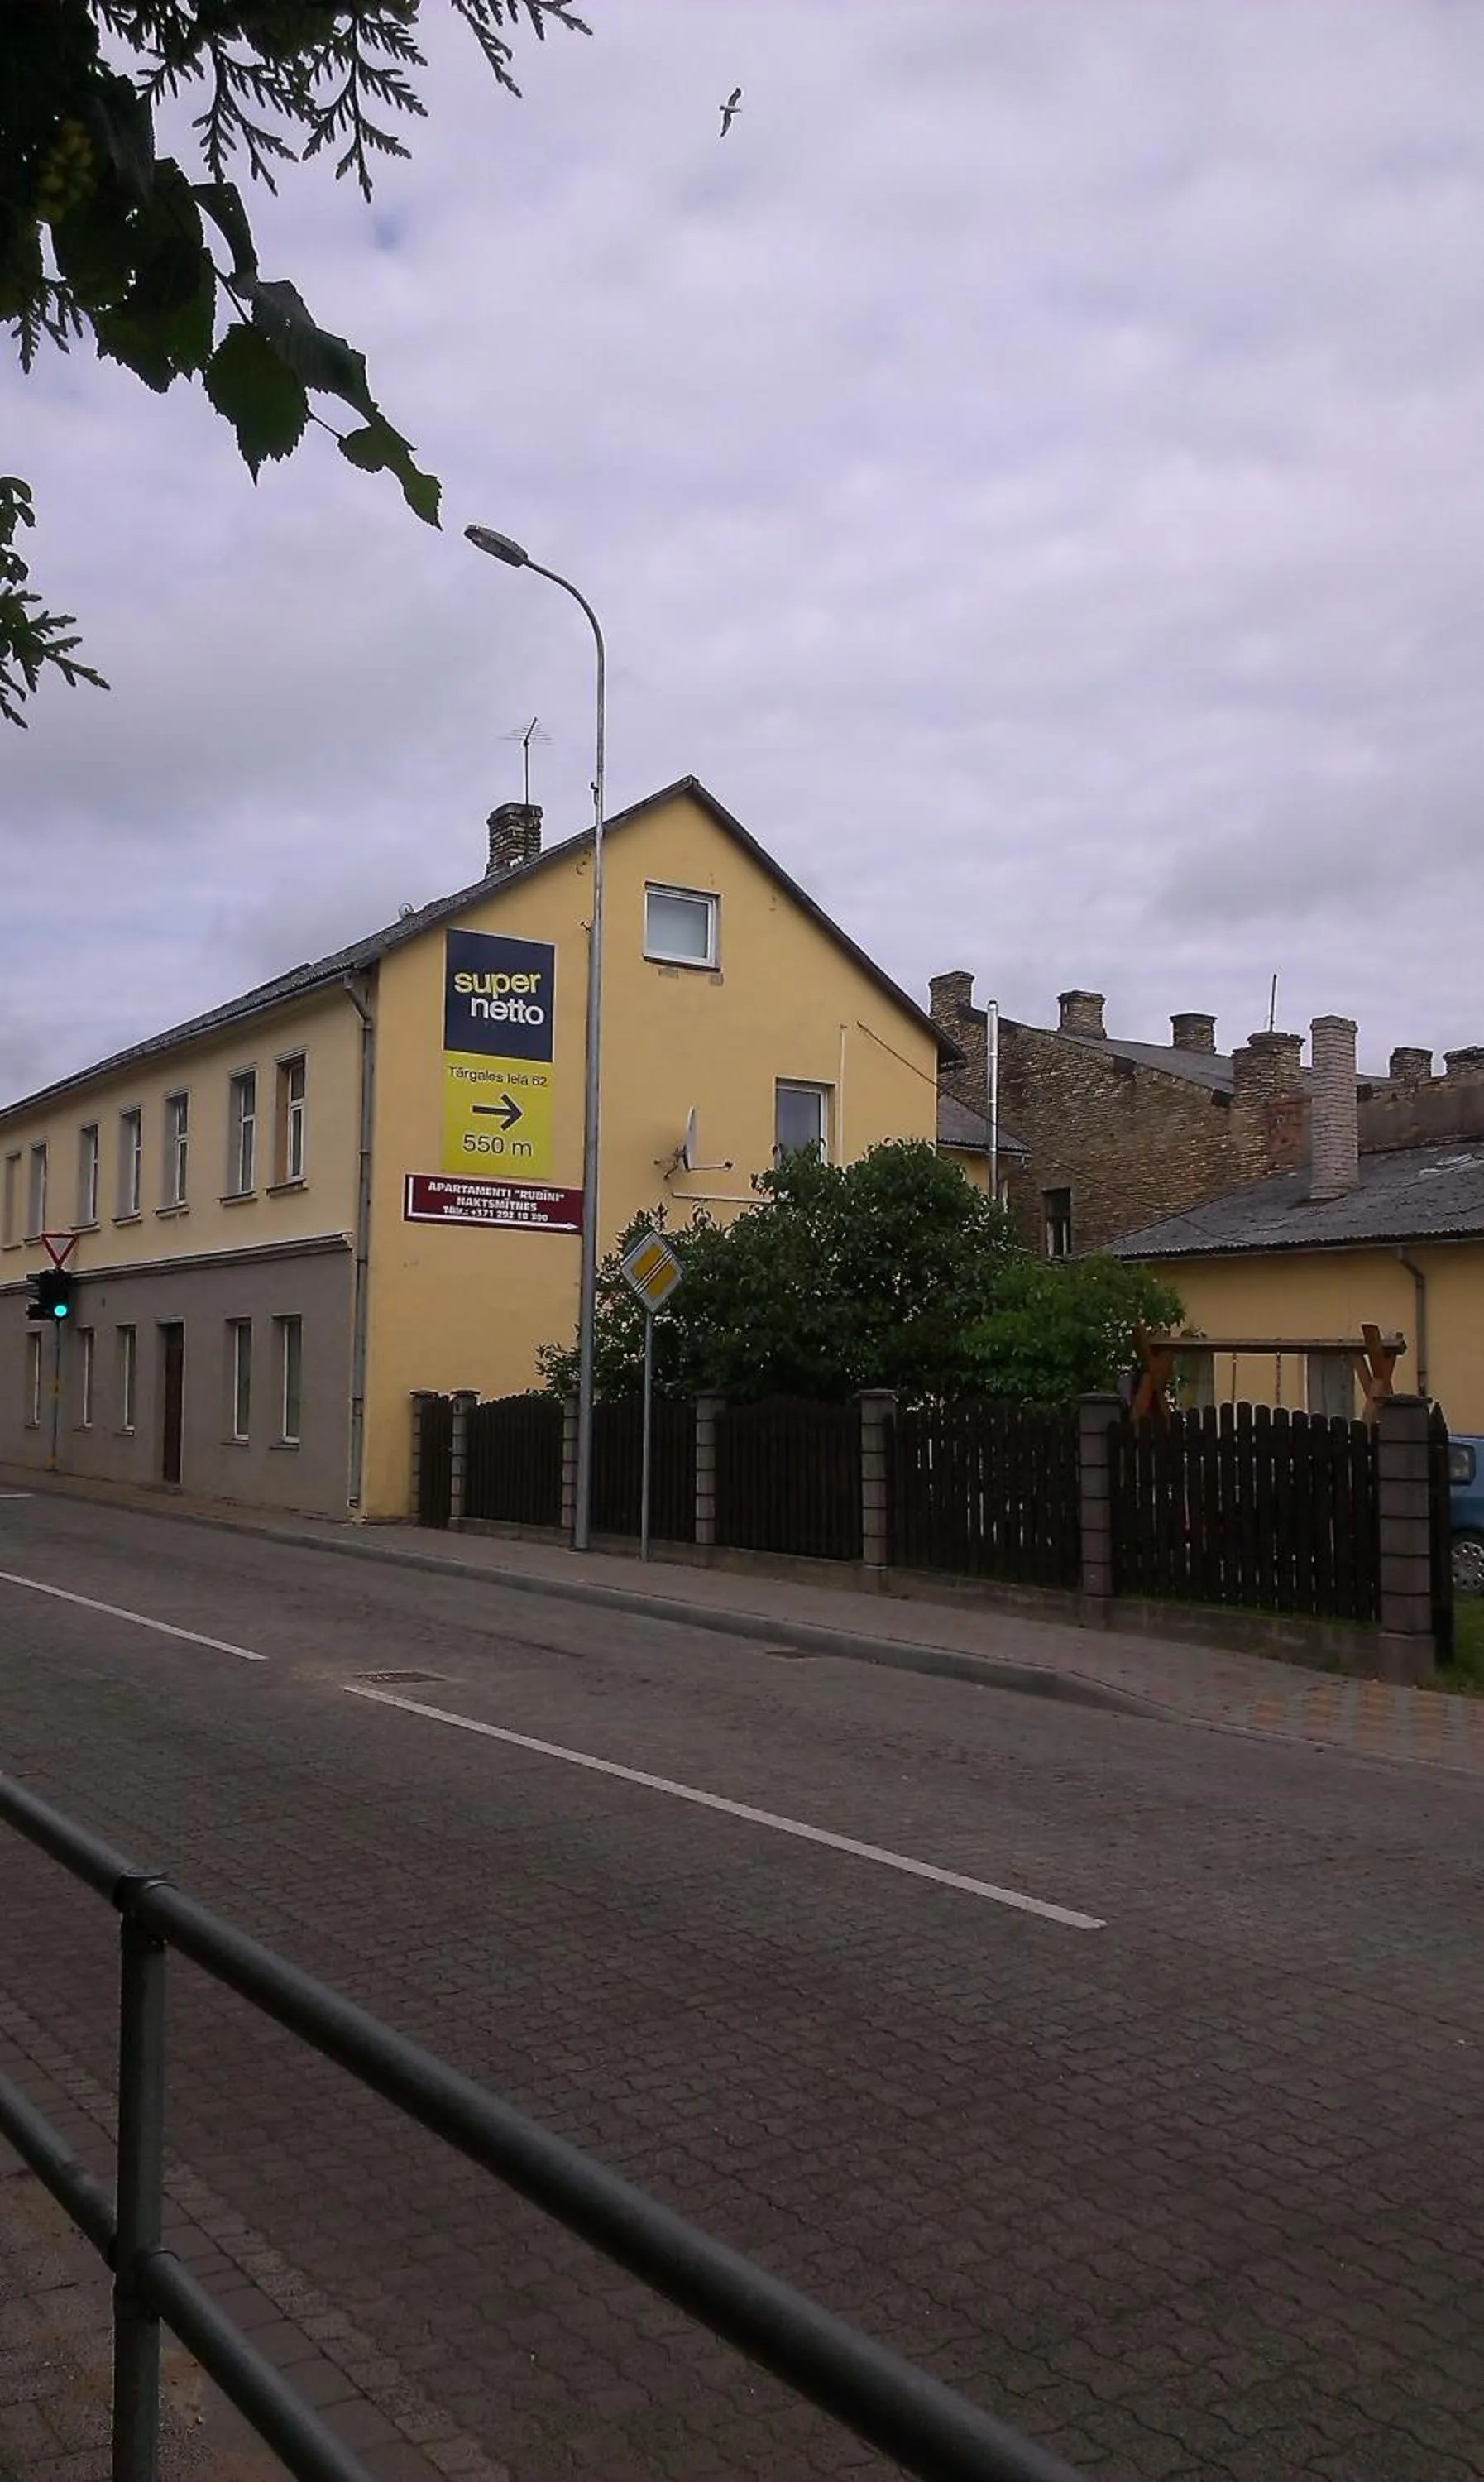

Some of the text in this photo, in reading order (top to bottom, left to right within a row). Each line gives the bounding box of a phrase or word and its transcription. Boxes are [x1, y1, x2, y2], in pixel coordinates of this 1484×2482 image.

[454, 971, 542, 1000] super
[470, 995, 545, 1026] netto
[462, 1134, 533, 1157] 550 m
[428, 1181, 512, 1197] APARTAMENTI
